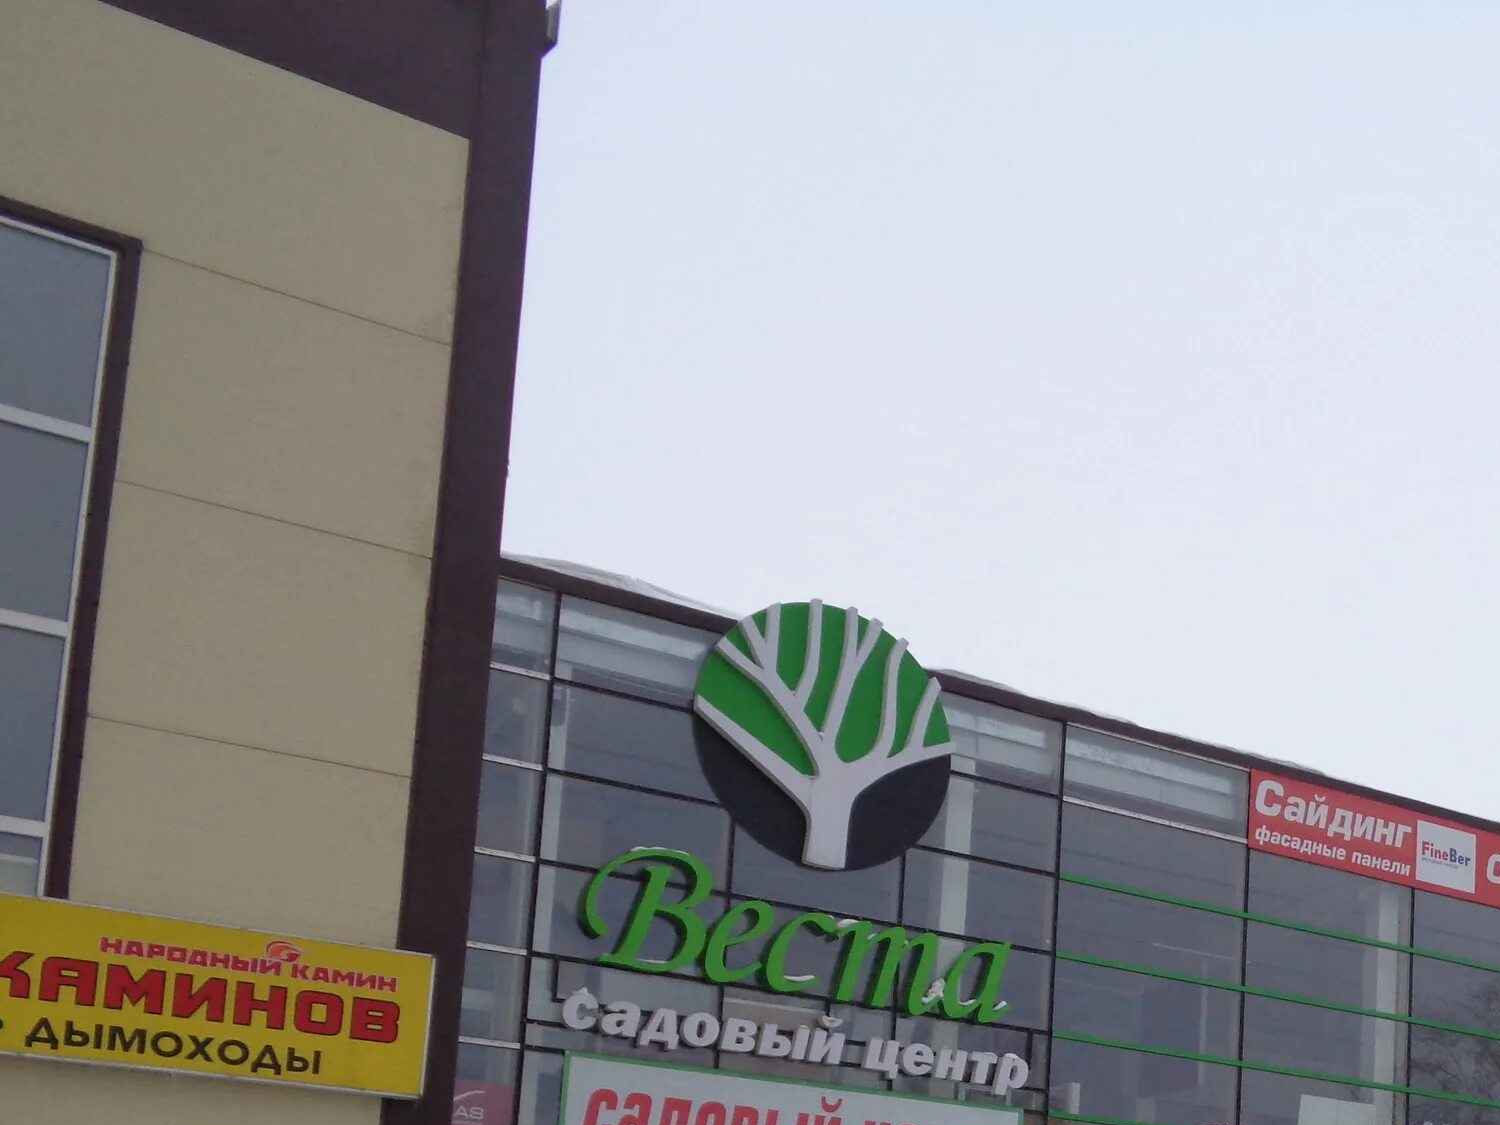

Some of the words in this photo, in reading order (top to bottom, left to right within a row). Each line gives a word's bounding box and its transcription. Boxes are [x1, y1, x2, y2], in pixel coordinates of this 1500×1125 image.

[1255, 780, 1411, 848] Сайдинг
[1255, 825, 1347, 861] фасадные
[1352, 850, 1410, 877] панели
[1422, 841, 1471, 866] FineBer
[579, 846, 1012, 1024] Веста
[100, 937, 282, 977] НАРОДНЫЙ
[291, 965, 398, 992] КАМИН
[25, 1017, 322, 1075] ДЫМОХОДЫ
[562, 989, 846, 1066] садовый
[864, 1033, 1030, 1094] центр
